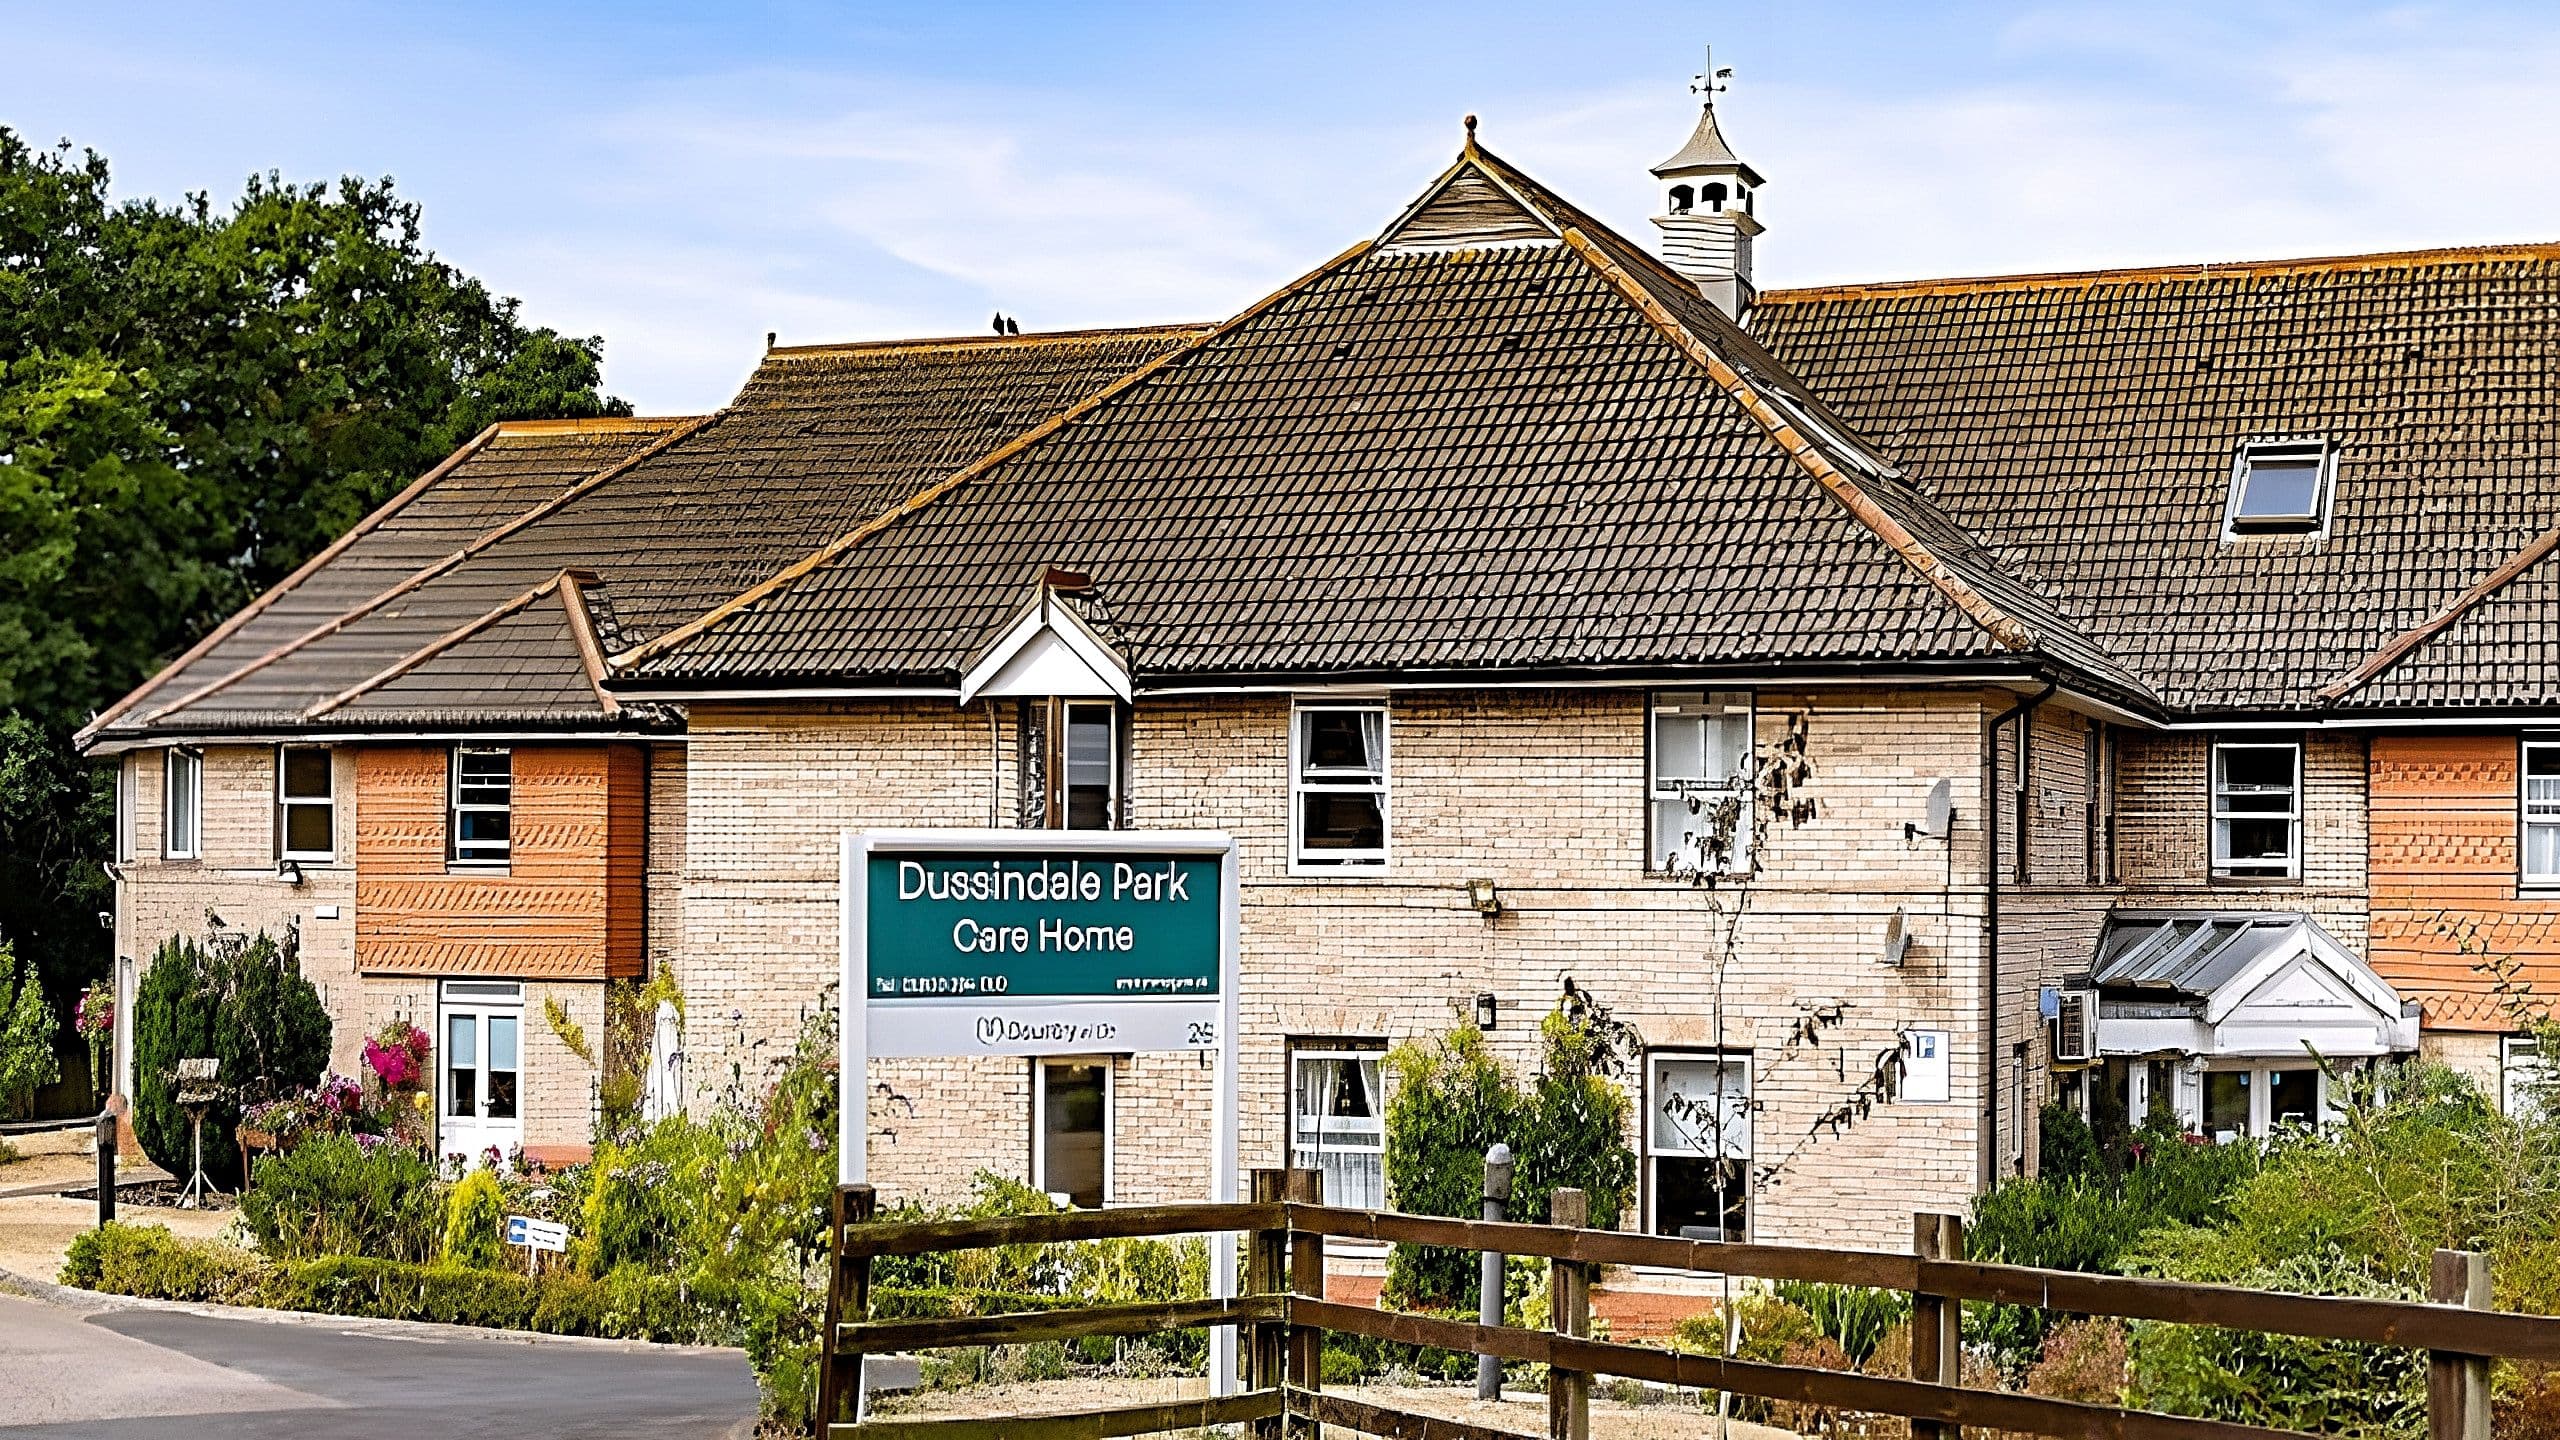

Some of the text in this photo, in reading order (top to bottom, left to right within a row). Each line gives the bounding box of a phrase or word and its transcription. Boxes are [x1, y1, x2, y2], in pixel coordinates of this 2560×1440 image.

[899, 860, 1190, 901] Dussindale Park
[953, 918, 1135, 954] Care Home
